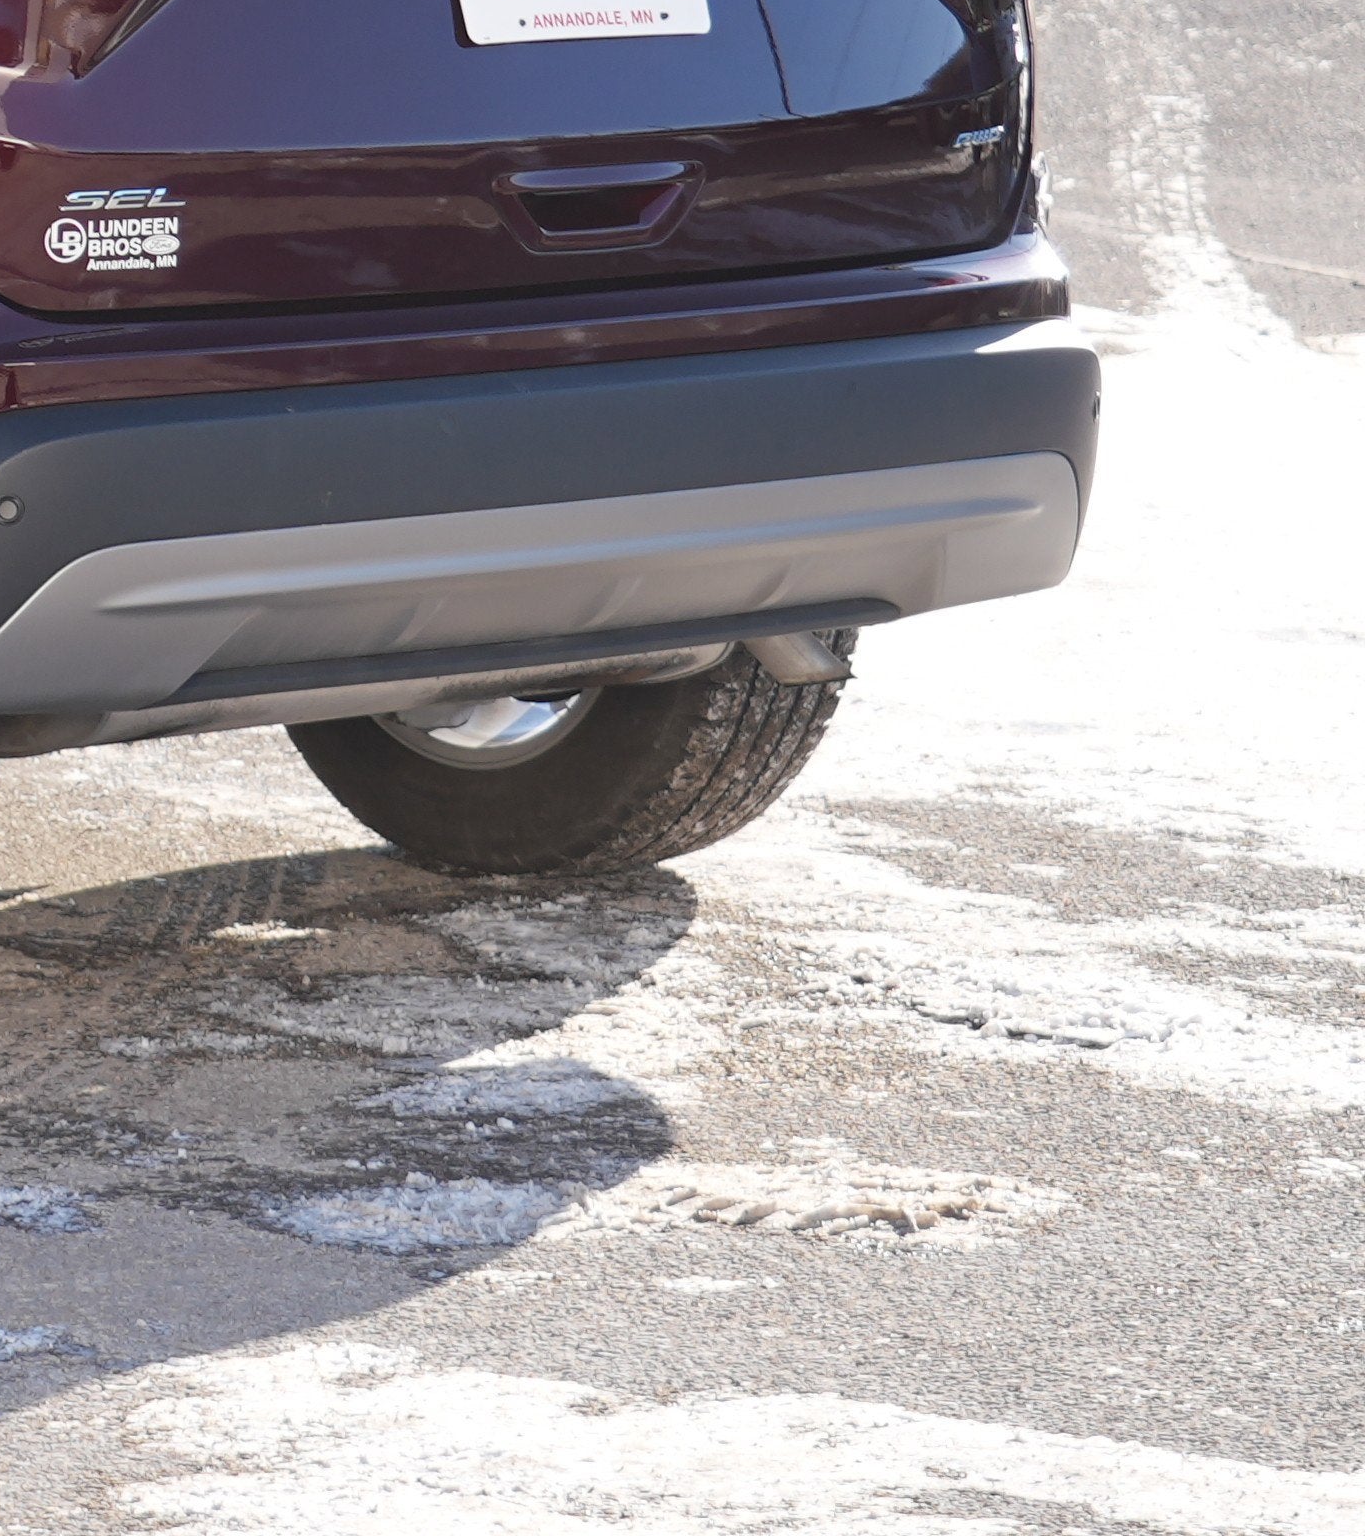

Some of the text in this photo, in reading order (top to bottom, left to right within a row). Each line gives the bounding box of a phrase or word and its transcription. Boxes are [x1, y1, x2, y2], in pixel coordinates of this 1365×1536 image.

[533, 10, 655, 30] ANNANDALE, MN
[59, 188, 187, 212] SEL
[87, 217, 179, 238] LUNDEEN
[87, 237, 142, 257] BROS
[87, 254, 177, 272] Annandale, MN
